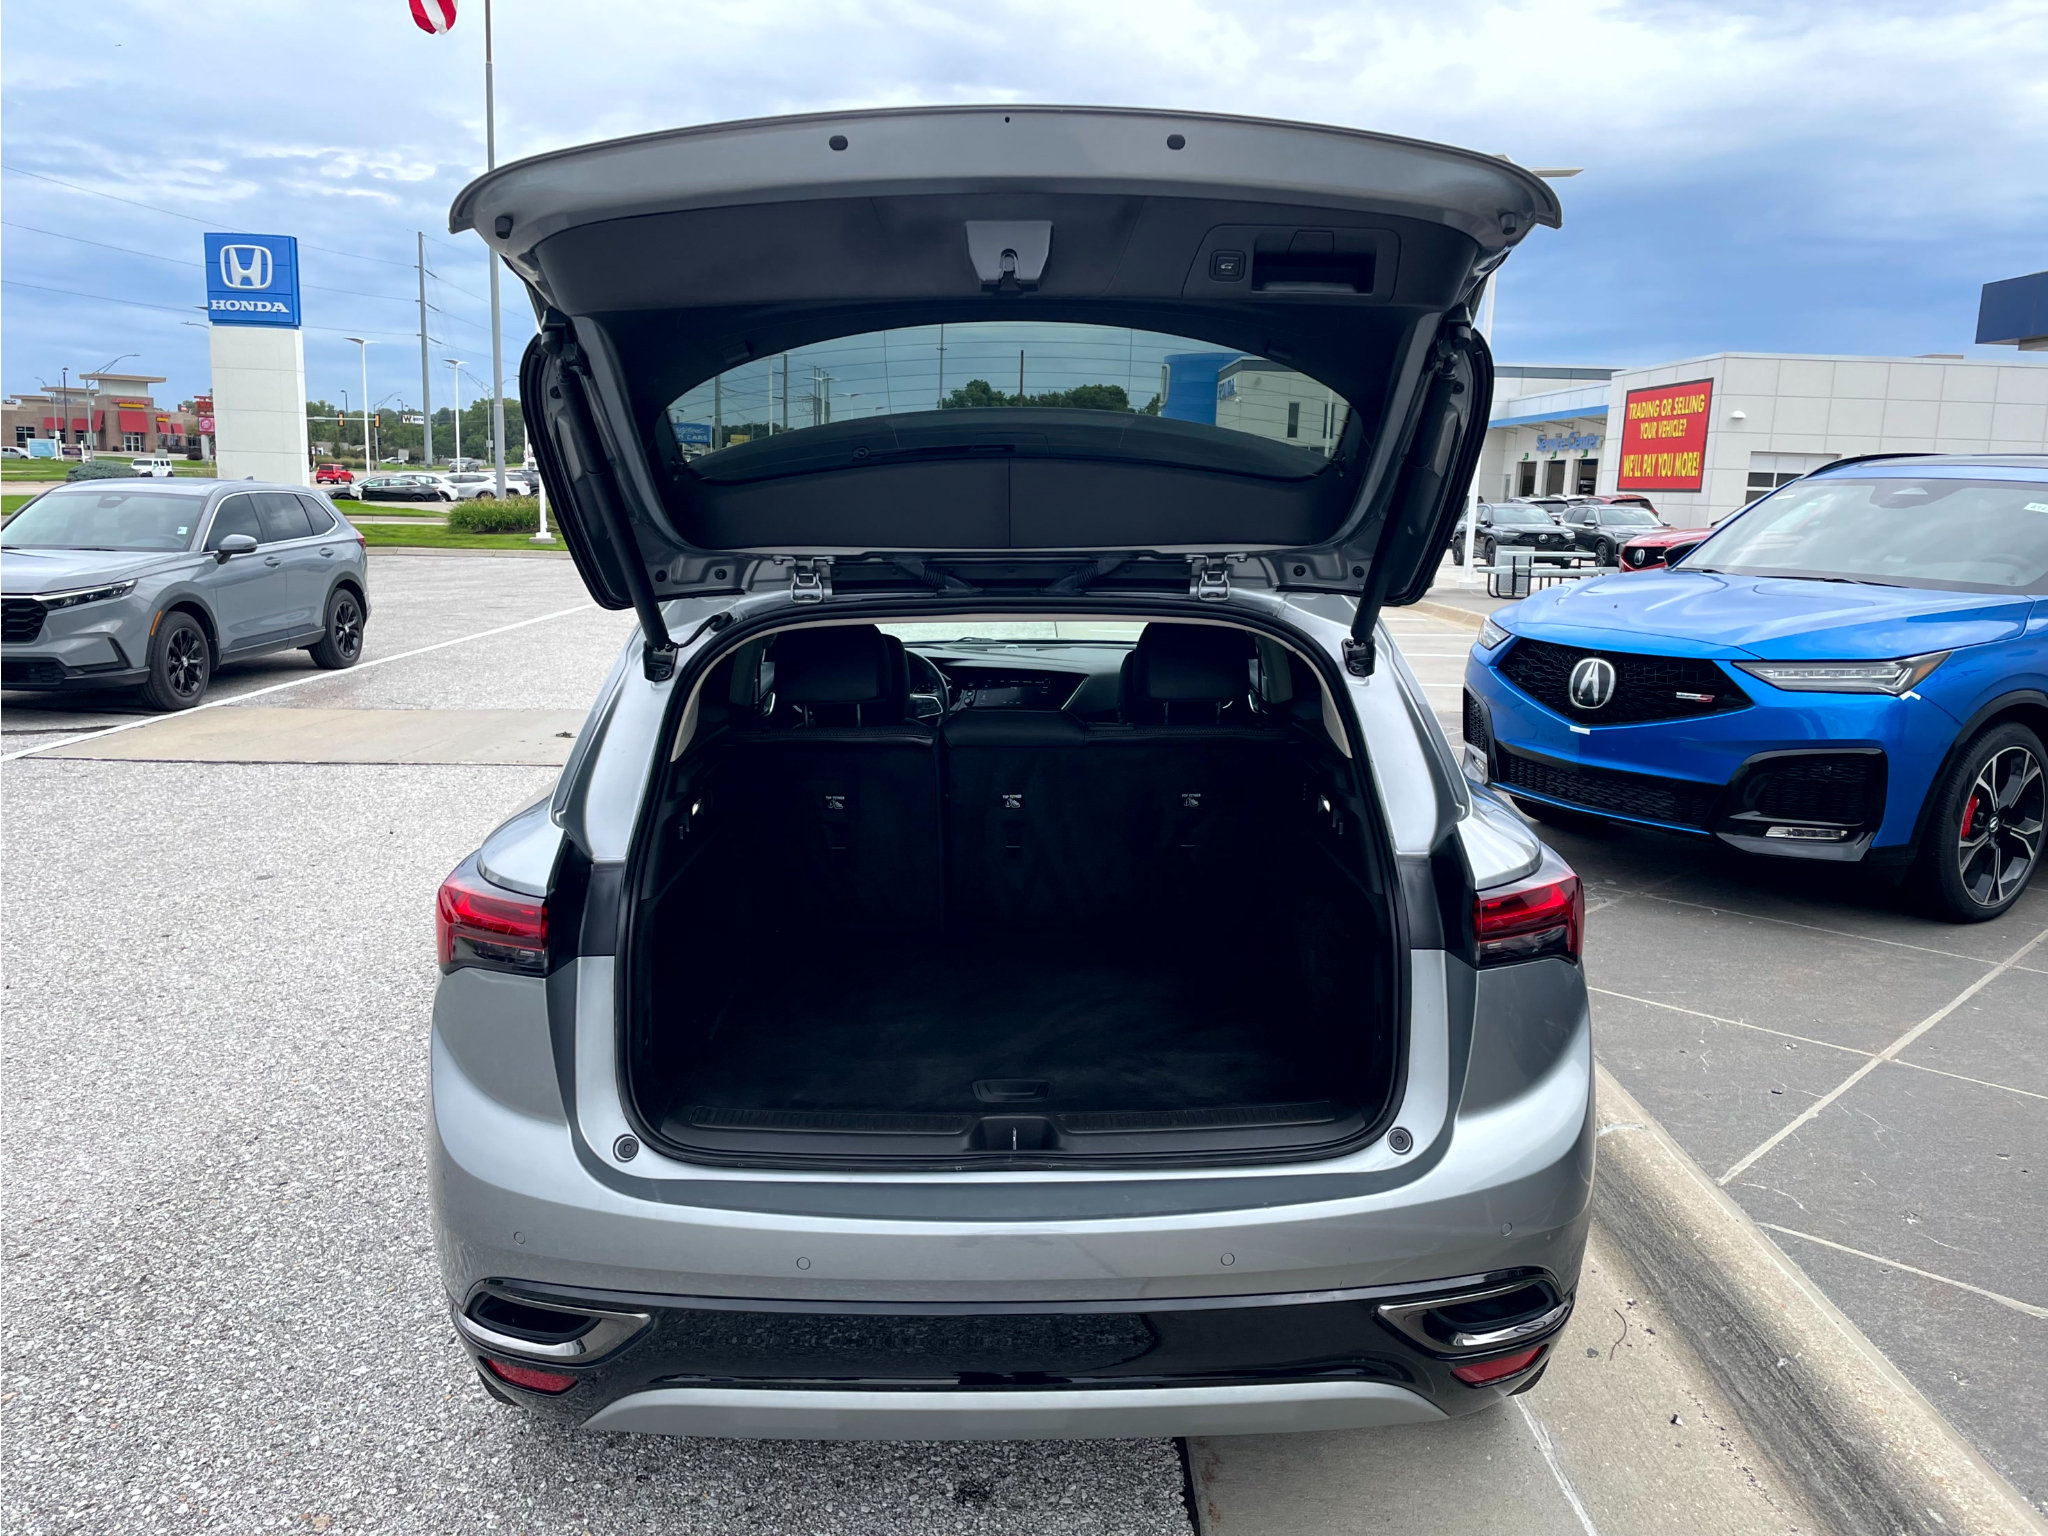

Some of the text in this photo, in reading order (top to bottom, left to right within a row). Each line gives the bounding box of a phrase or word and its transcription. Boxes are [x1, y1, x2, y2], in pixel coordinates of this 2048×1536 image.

[211, 300, 290, 313] HONDA
[1629, 393, 1705, 420] TRADING OR SELLING
[1640, 418, 1687, 440] YOUR VEHICLE?
[1536, 431, 1600, 452] Service Center
[1623, 451, 1700, 478] WE'LL PAY YOU MORE!
